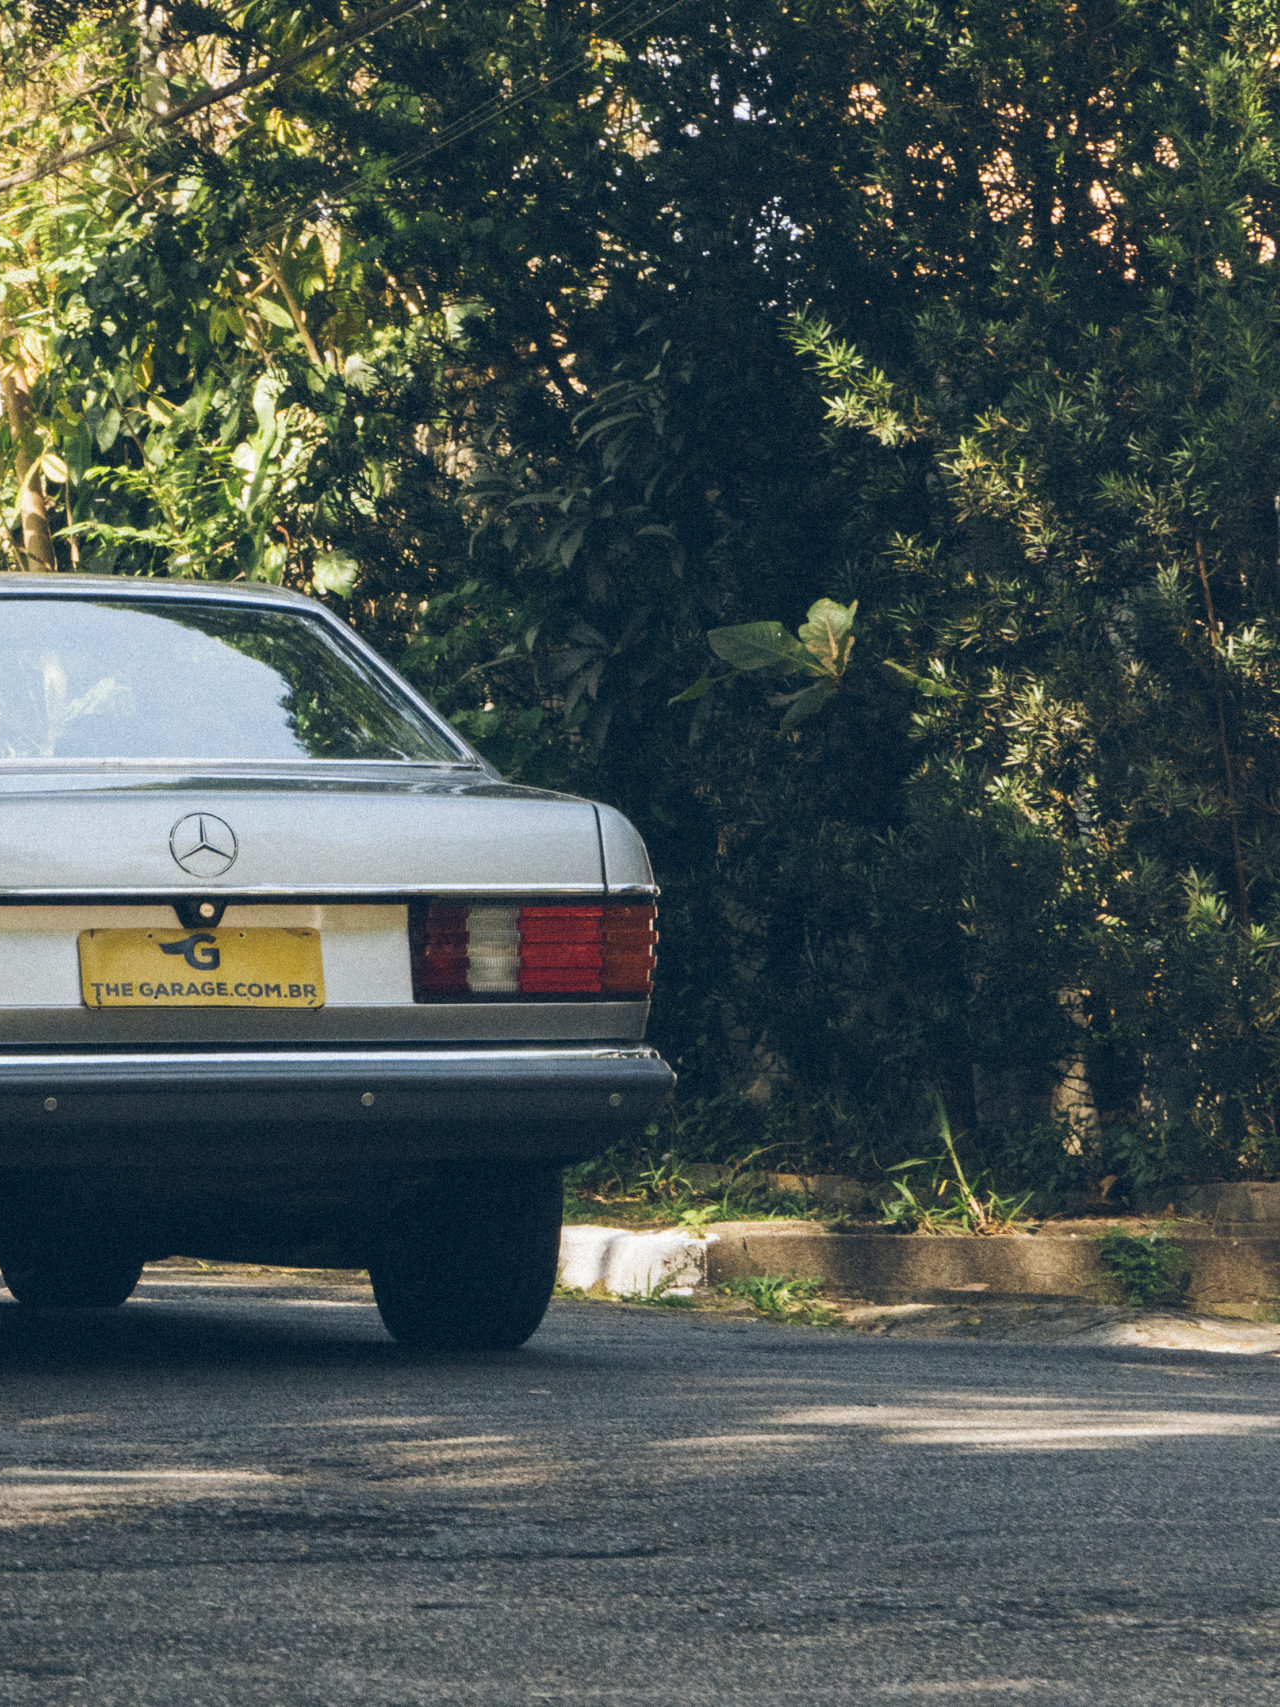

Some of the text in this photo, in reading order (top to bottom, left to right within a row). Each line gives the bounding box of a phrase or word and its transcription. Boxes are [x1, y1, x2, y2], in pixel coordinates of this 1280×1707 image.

[183, 933, 221, 971] G
[91, 981, 317, 999] THE GARAGE.COM.BR
